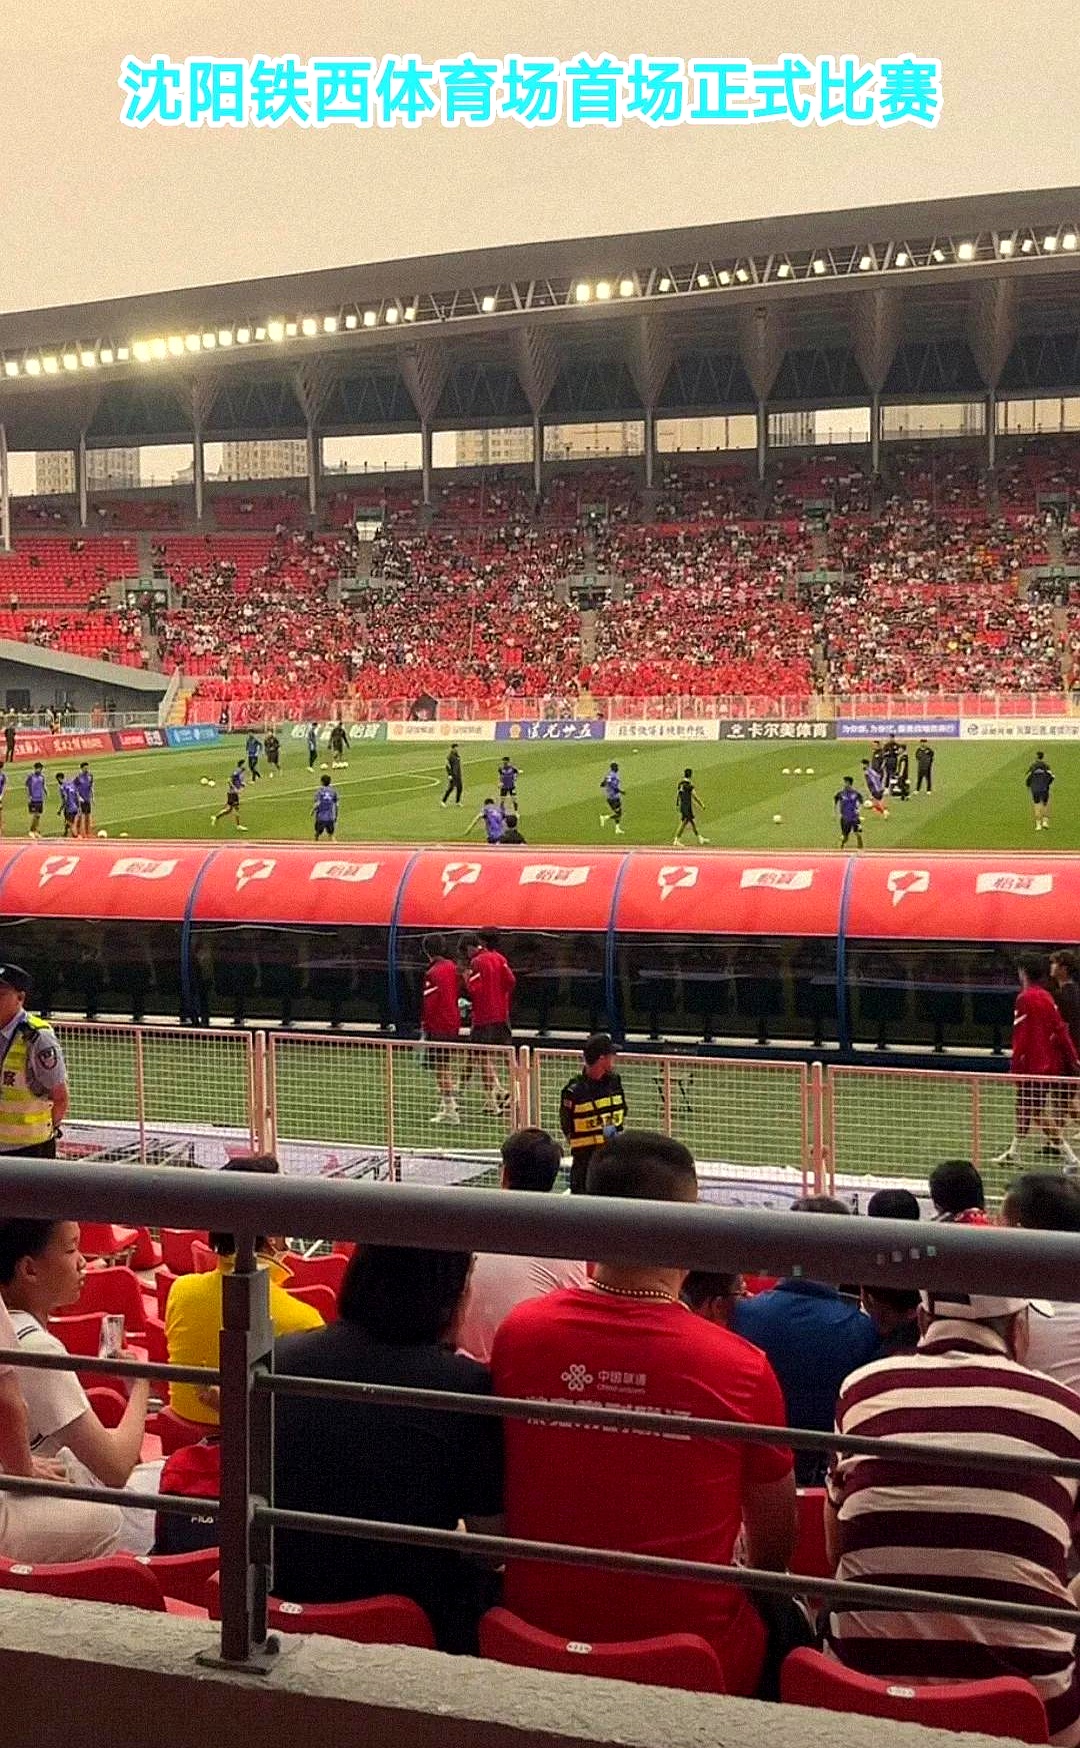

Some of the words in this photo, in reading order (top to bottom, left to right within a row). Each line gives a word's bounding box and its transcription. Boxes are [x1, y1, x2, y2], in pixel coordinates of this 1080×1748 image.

[748, 722, 828, 738] 卡尔美体育
